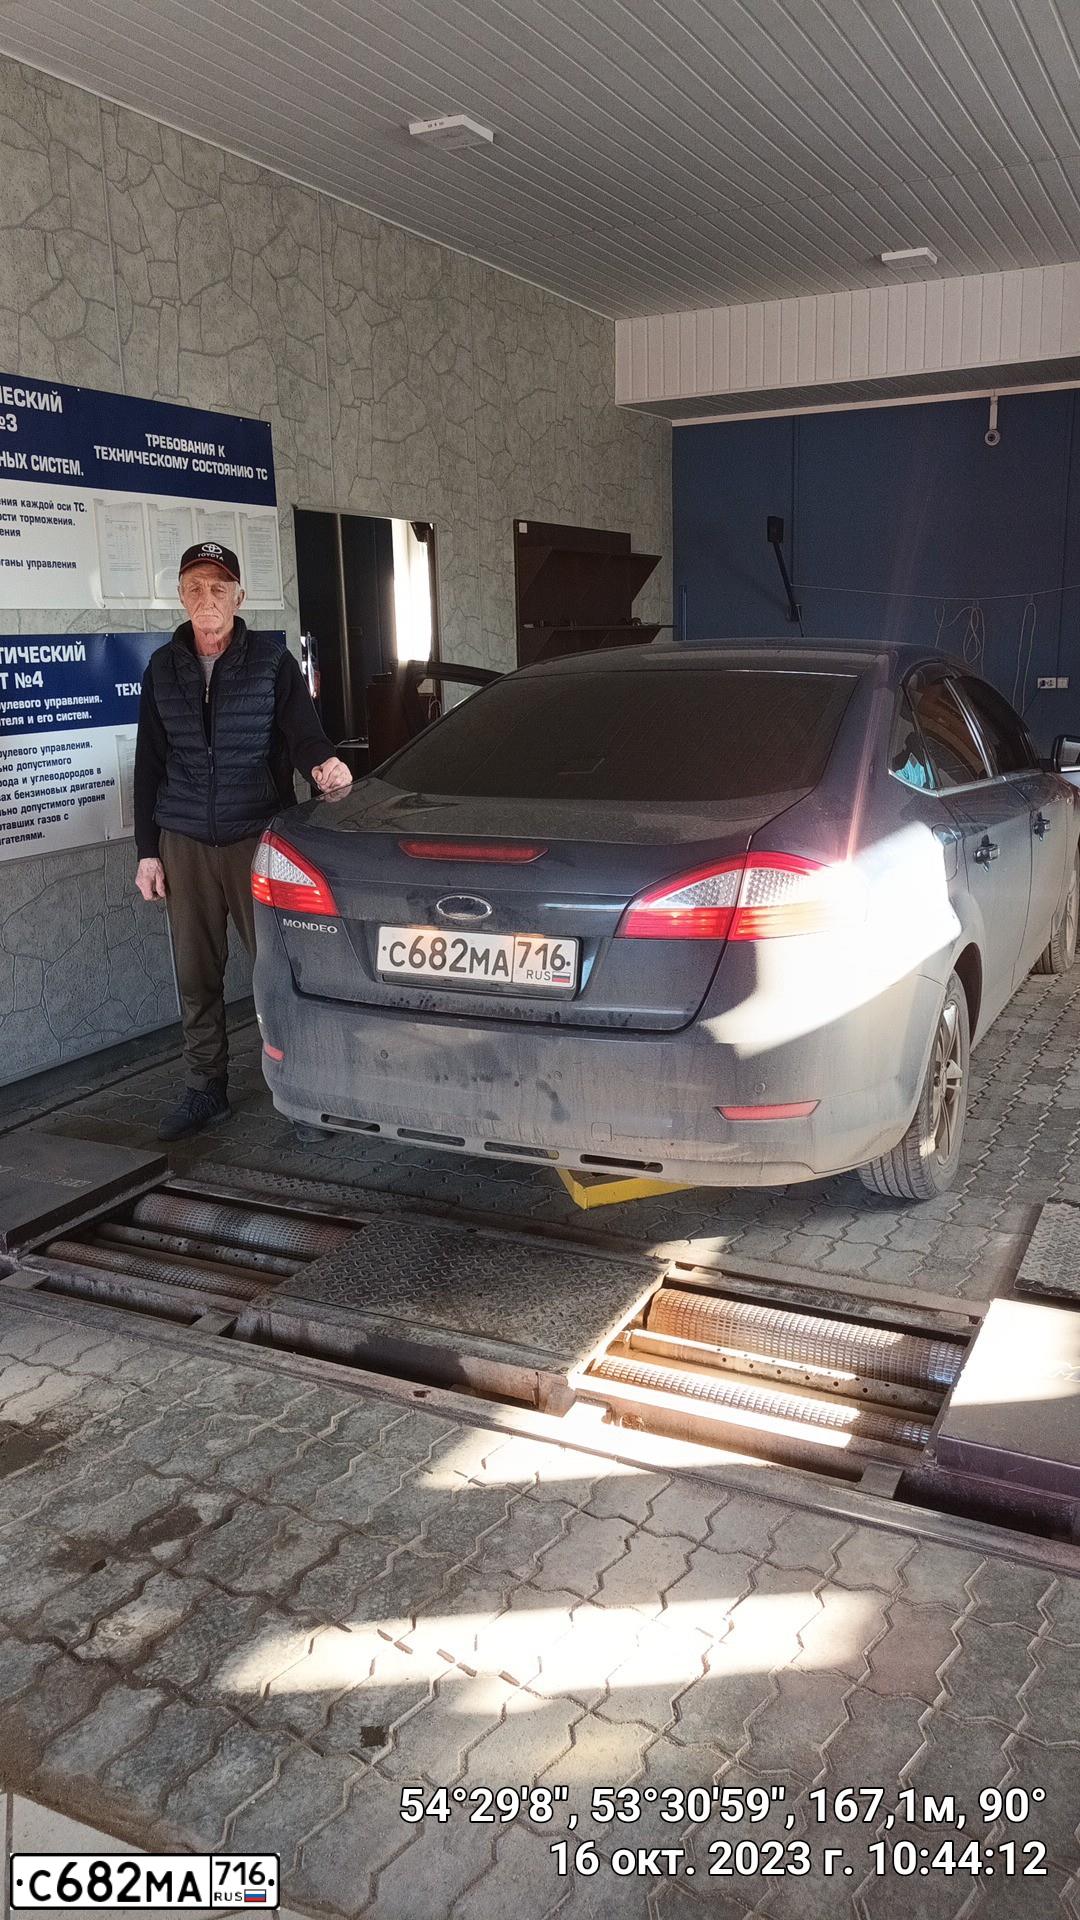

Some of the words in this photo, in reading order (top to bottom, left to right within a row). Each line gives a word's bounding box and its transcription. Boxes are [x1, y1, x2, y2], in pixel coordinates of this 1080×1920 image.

[145, 433, 215, 455] ТРЕБОВАНИЯ
[218, 445, 226, 458] К
[30, 454, 84, 476] СИСТЕМ.
[93, 445, 189, 470] ТЕХНИЧЕСКОМУ
[191, 458, 254, 479] СОСТОЯНИЮ
[256, 467, 268, 480] ТС
[0, 498, 18, 507] ния
[20, 500, 55, 510] каждой
[56, 502, 72, 511] оси
[73, 502, 88, 513] ТС.
[19, 514, 76, 526] торможения.
[26, 559, 77, 570] управления
[197, 553, 225, 561] TOYOTA
[14, 670, 44, 689] №4
[0, 699, 42, 714] улевого
[43, 695, 103, 710] управления.
[0, 716, 25, 727] теля
[27, 715, 34, 724] и
[36, 714, 54, 723] его
[55, 711, 92, 722] систем.
[40, 741, 93, 756] управления.
[16, 757, 72, 772] допустимого
[21, 777, 28, 785] и
[30, 768, 95, 786] углеводородов
[96, 767, 102, 775] в
[0, 794, 12, 803] ах
[14, 785, 68, 800] бензиновых
[70, 777, 115, 793] двигателей
[20, 798, 76, 815] допустимого
[77, 793, 106, 807] уровня
[37, 813, 62, 825] газов
[282, 917, 338, 934] MONDEO
[525, 969, 552, 981] RUS
